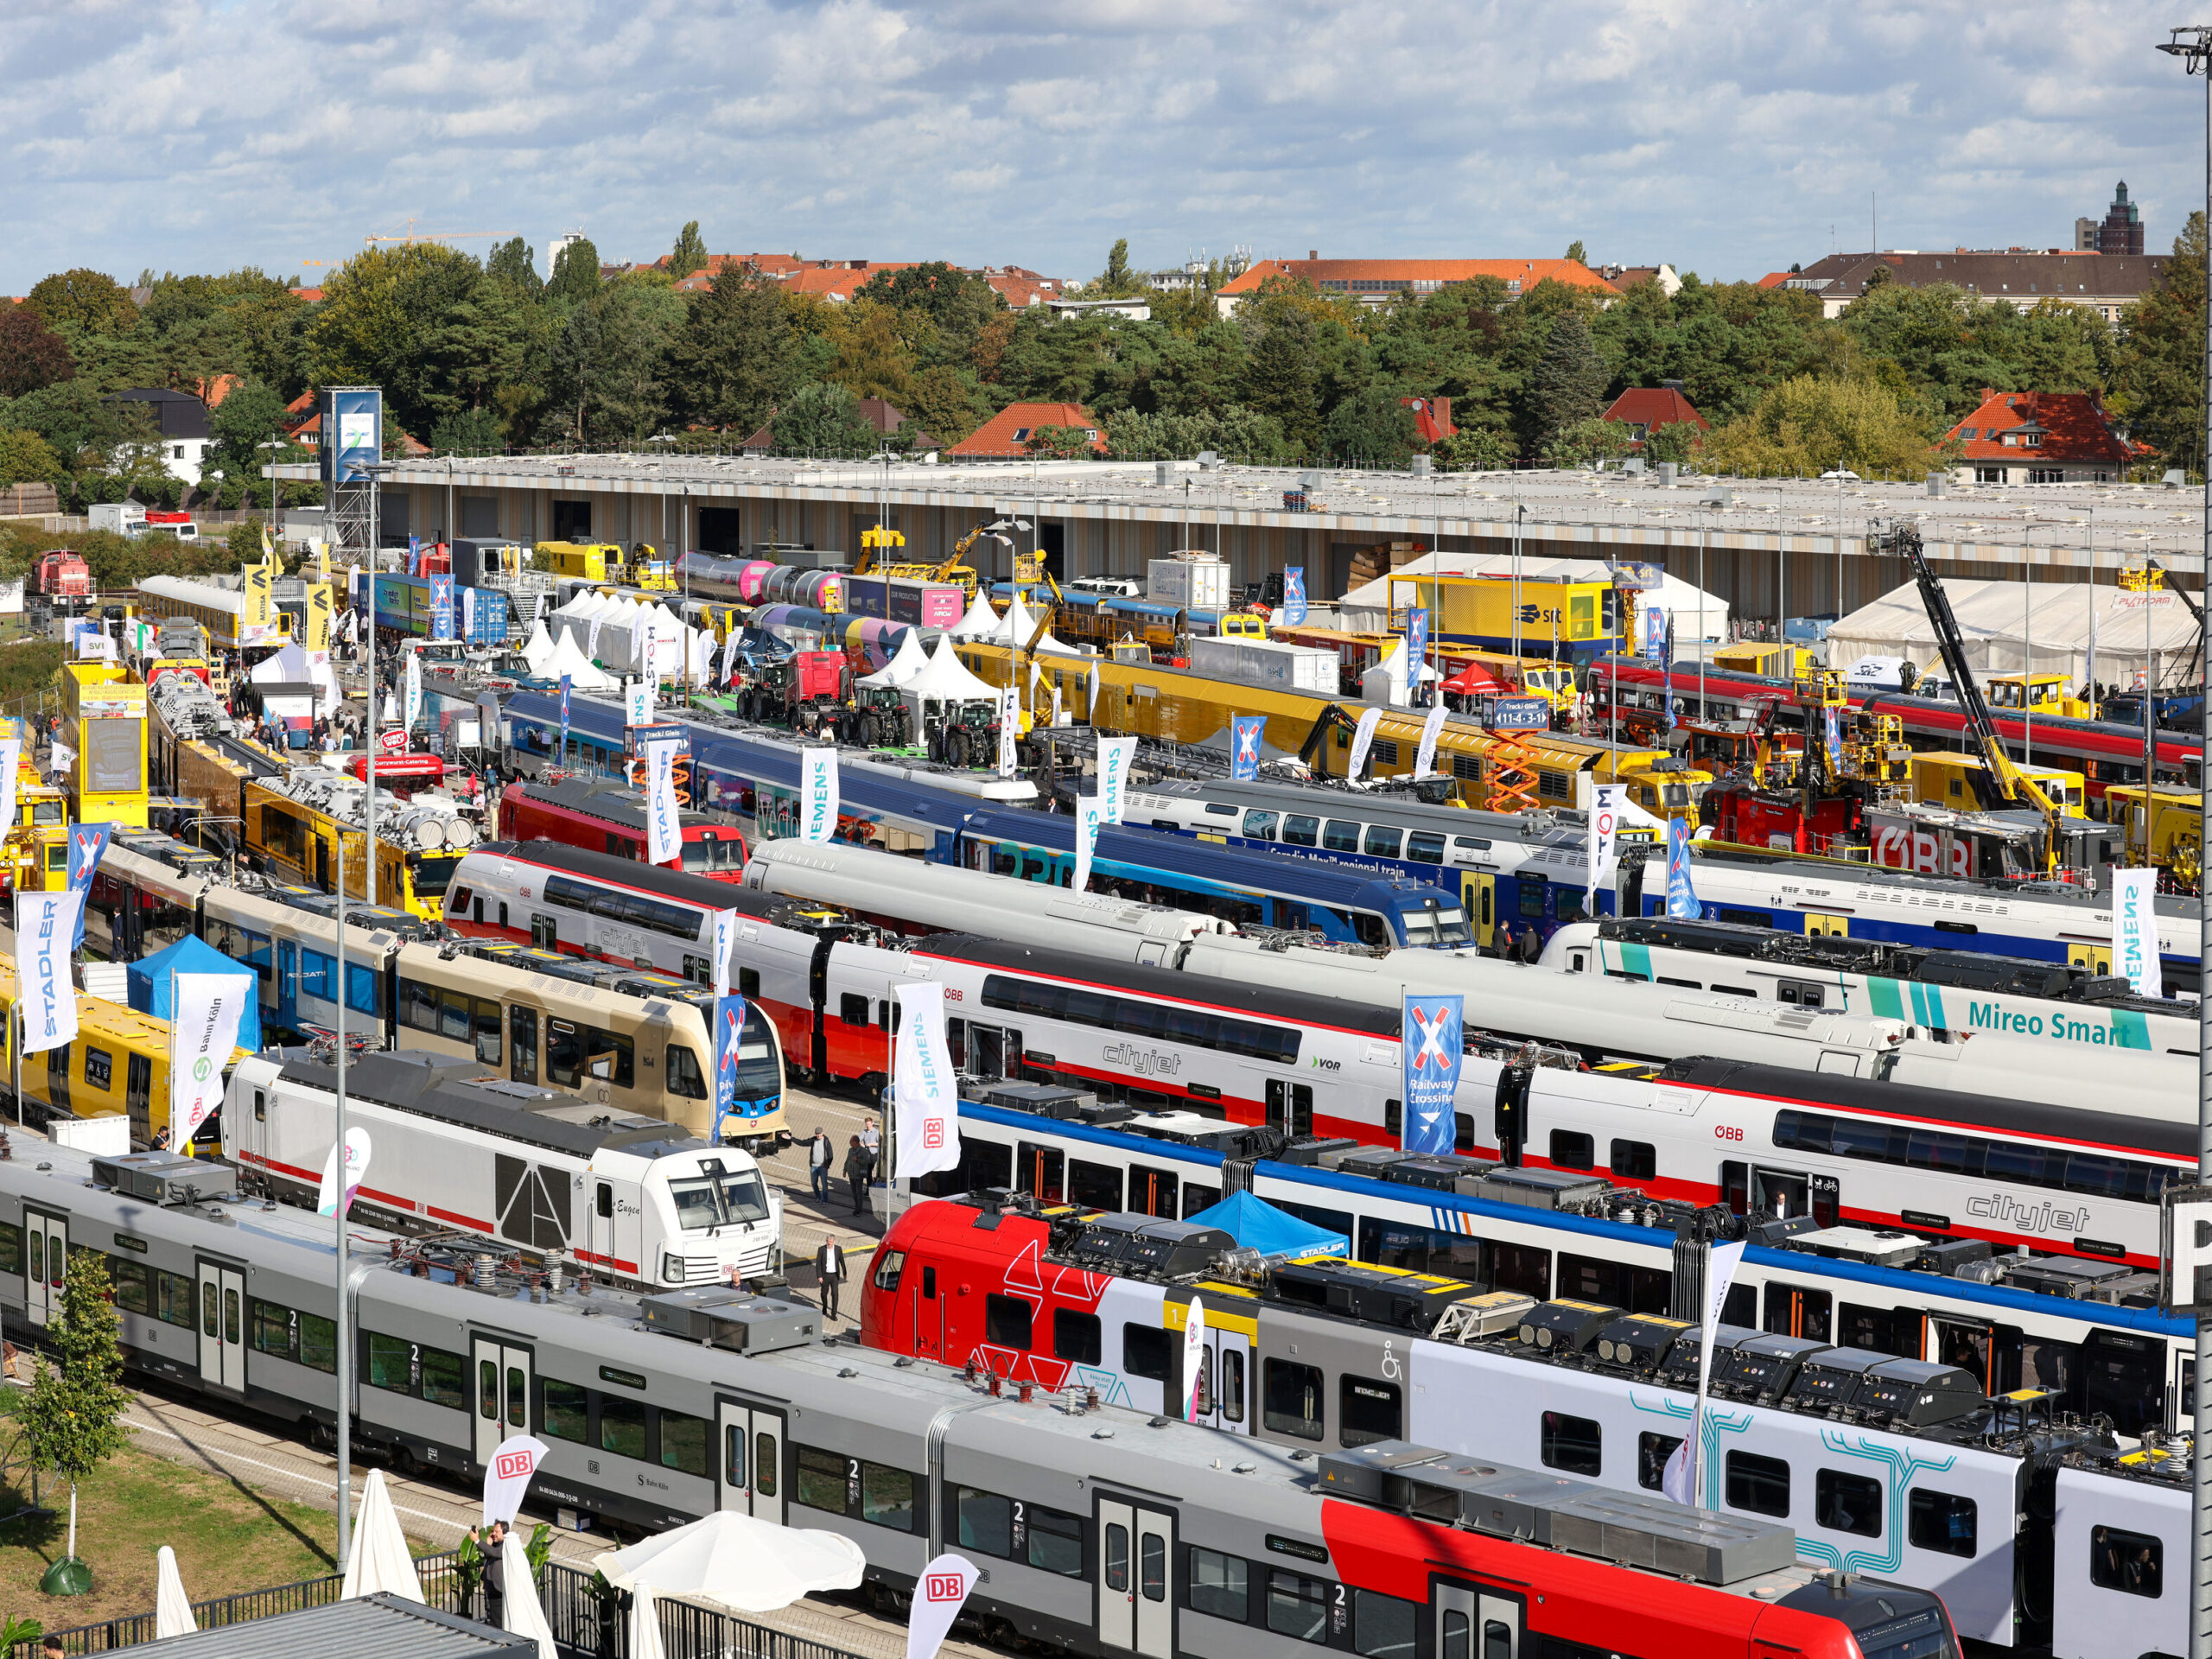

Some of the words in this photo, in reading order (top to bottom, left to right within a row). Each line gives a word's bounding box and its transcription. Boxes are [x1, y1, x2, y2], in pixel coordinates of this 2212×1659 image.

[1639, 567, 1654, 578] srt
[898, 592, 919, 601] PRODUCTION
[1542, 607, 1562, 623] srt
[646, 626, 656, 693] LSTOM
[1502, 714, 1521, 723] 11-4
[1527, 714, 1541, 723] 3-1
[383, 734, 405, 743] CURRY
[385, 737, 404, 747] WOLF
[1107, 747, 1121, 823] IEMENS
[656, 750, 669, 854] STADLER
[810, 761, 827, 840] IEMENS
[1382, 863, 1406, 878] train
[1438, 868, 1442, 878] 2
[519, 886, 531, 898] ÖBB
[1548, 887, 1552, 897] 2
[1710, 908, 1715, 918] 2
[601, 928, 645, 956] cityjet
[37, 899, 57, 1037] STADLER
[944, 988, 963, 1001] ÖBB
[503, 1006, 509, 1019] 2
[200, 1024, 213, 1052] Bahn
[208, 998, 222, 1022] Köln
[539, 1017, 544, 1030] 2
[1969, 1001, 2044, 1036] Mireo
[2050, 1013, 2131, 1048] Smart
[1103, 1043, 1182, 1075] cityjet
[1319, 1058, 1341, 1071] VOR
[1409, 1079, 1454, 1090] Railway
[1409, 1092, 1453, 1105] Crossing
[925, 1119, 942, 1147] DB
[1714, 1125, 1744, 1141] ÖBB
[617, 1199, 640, 1219] Eugen
[1966, 1193, 2090, 1233] cityjet
[1300, 1243, 1345, 1258] STADLER
[722, 1265, 734, 1274] DB
[289, 1310, 297, 1328] 2
[1172, 1308, 1178, 1324] 1
[411, 1344, 419, 1362] 2
[499, 1452, 530, 1477] DB
[589, 1461, 599, 1473] DB
[849, 1459, 859, 1478] 2
[638, 1474, 645, 1486] S
[646, 1478, 658, 1488] Bahn
[658, 1481, 669, 1491] Köln
[1014, 1503, 1024, 1522] 2
[929, 1577, 961, 1599] DB
[1334, 1584, 1345, 1606] 2
